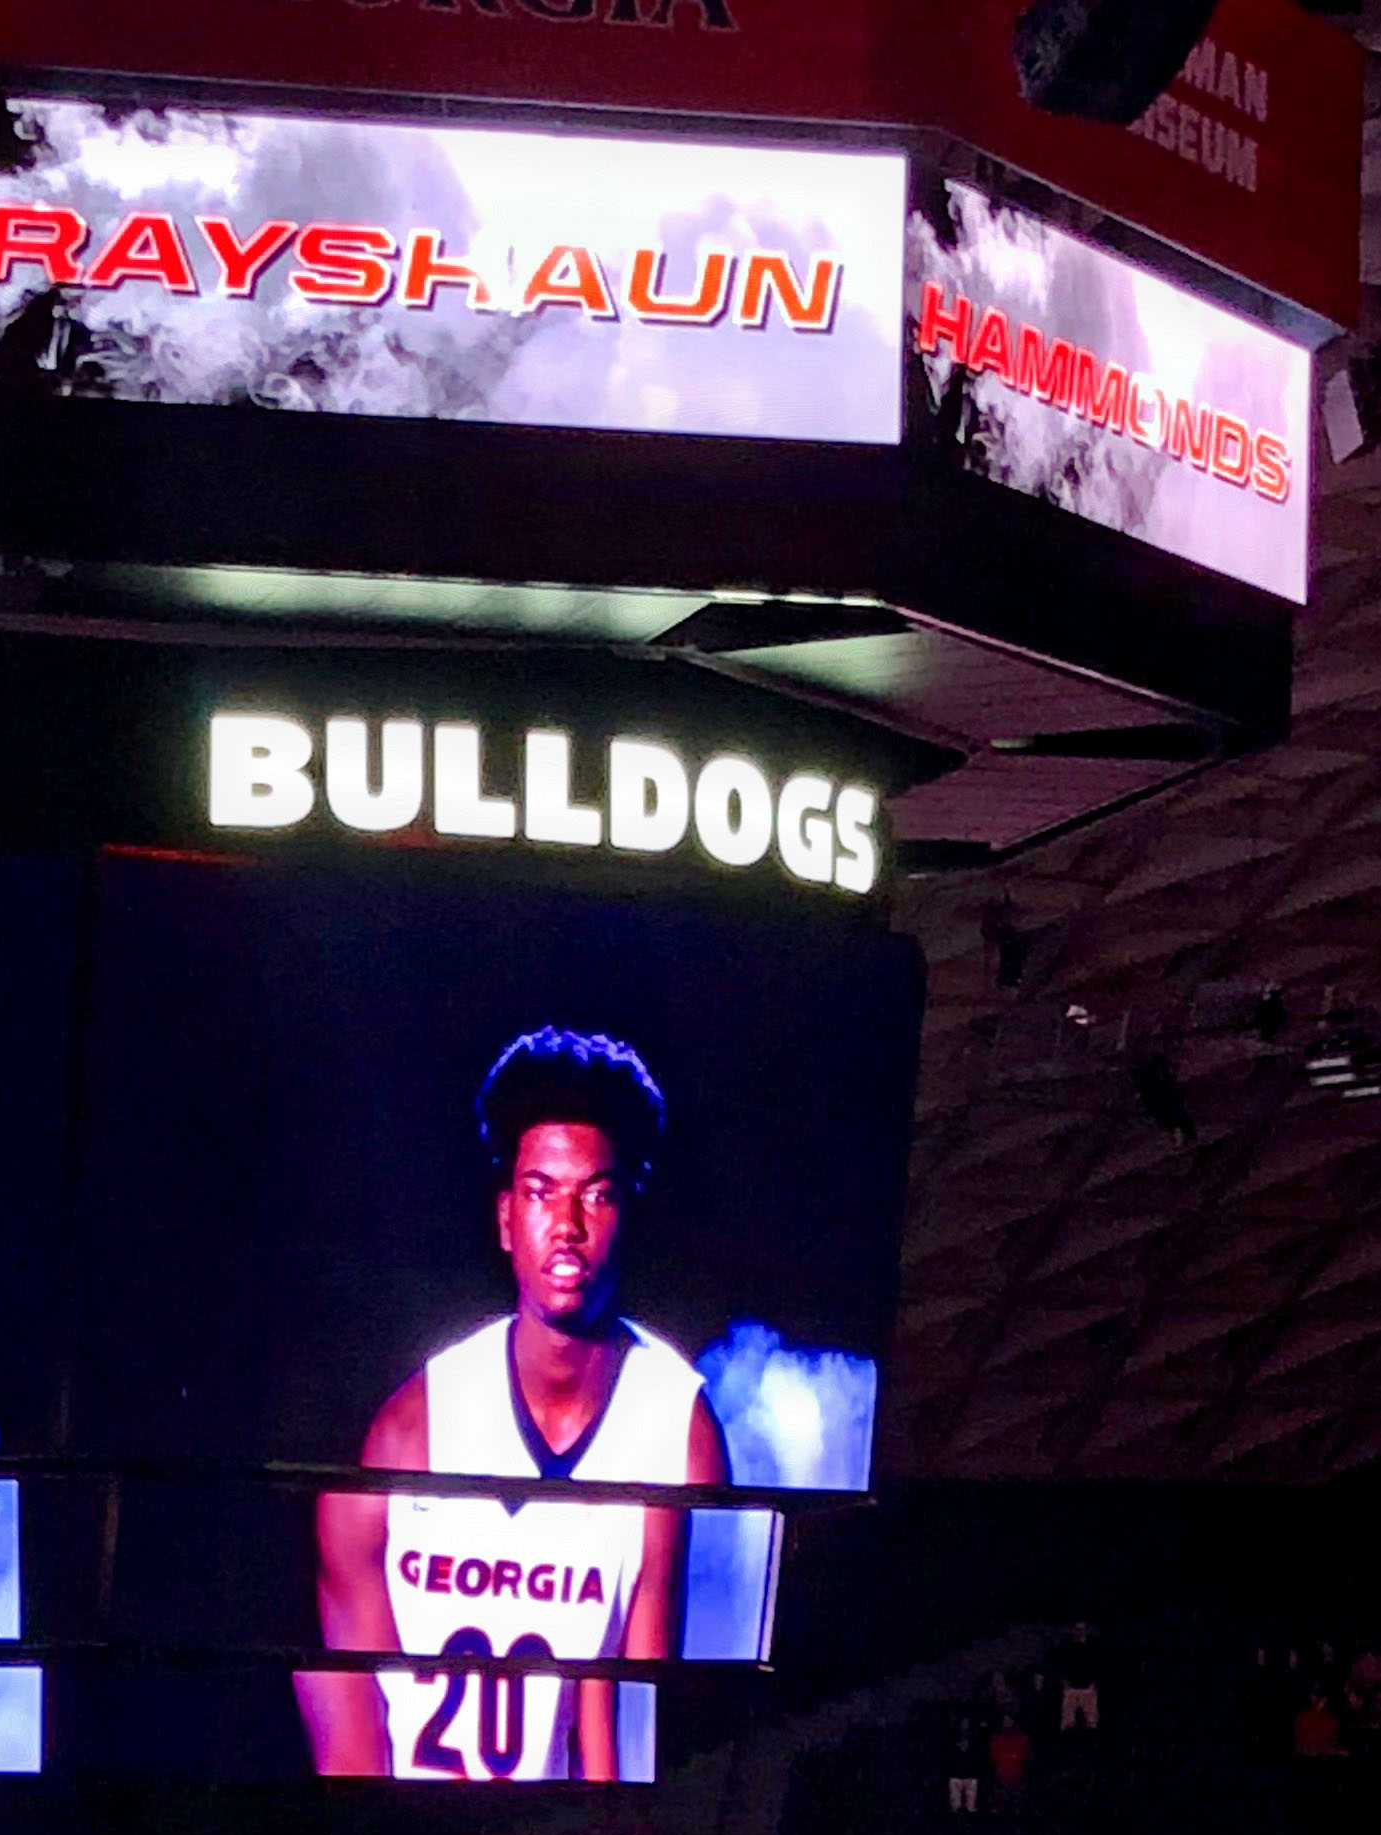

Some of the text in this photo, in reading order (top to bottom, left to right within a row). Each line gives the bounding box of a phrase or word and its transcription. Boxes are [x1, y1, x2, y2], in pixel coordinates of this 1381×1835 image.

[1126, 92, 1259, 193] ISEUM
[920, 282, 1289, 505] HAMMONDS
[209, 714, 875, 895] BULLDOGS
[400, 1550, 605, 1605] GEORGIA
[411, 1627, 552, 1778] 20
